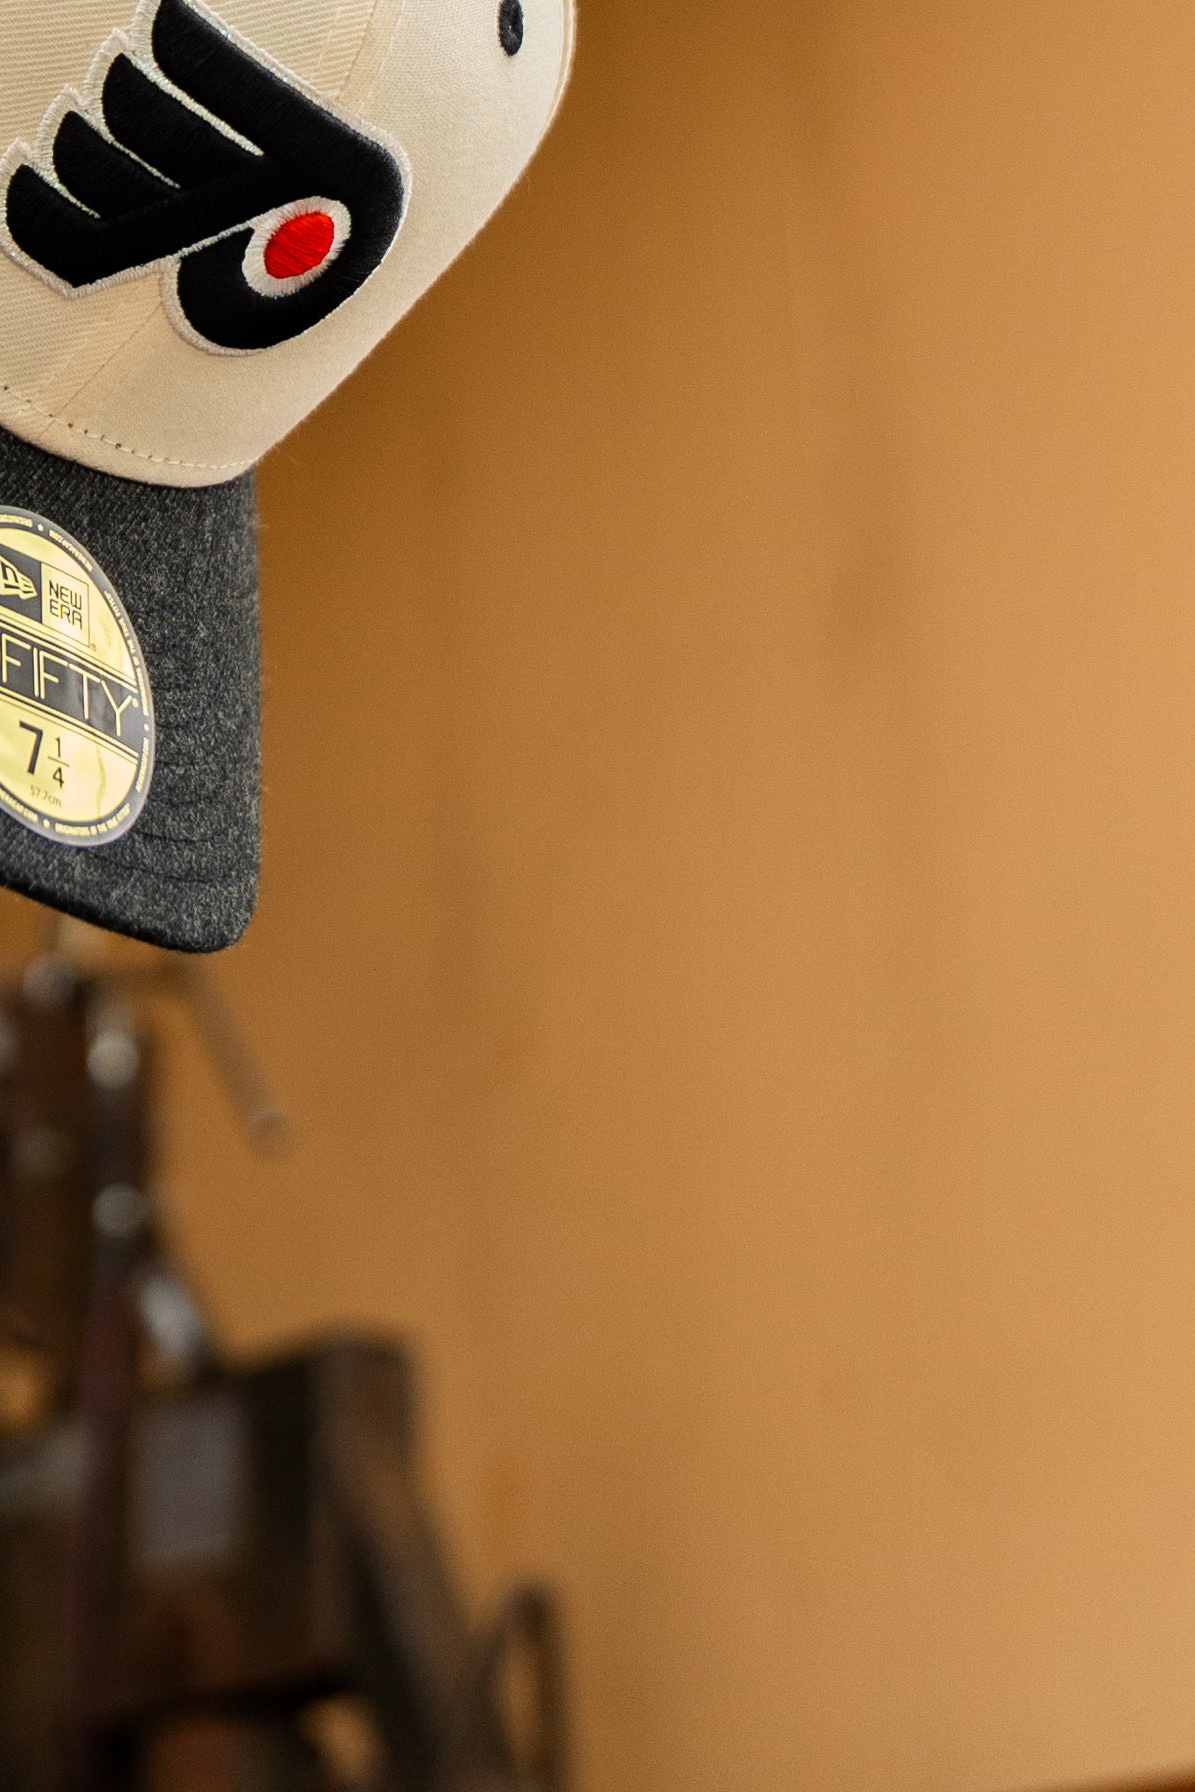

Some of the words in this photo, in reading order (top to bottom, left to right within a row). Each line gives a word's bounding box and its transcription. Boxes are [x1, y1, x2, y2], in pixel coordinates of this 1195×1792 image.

[49, 579, 82, 610] NEW
[49, 603, 83, 630] ERA
[19, 720, 44, 775] 7
